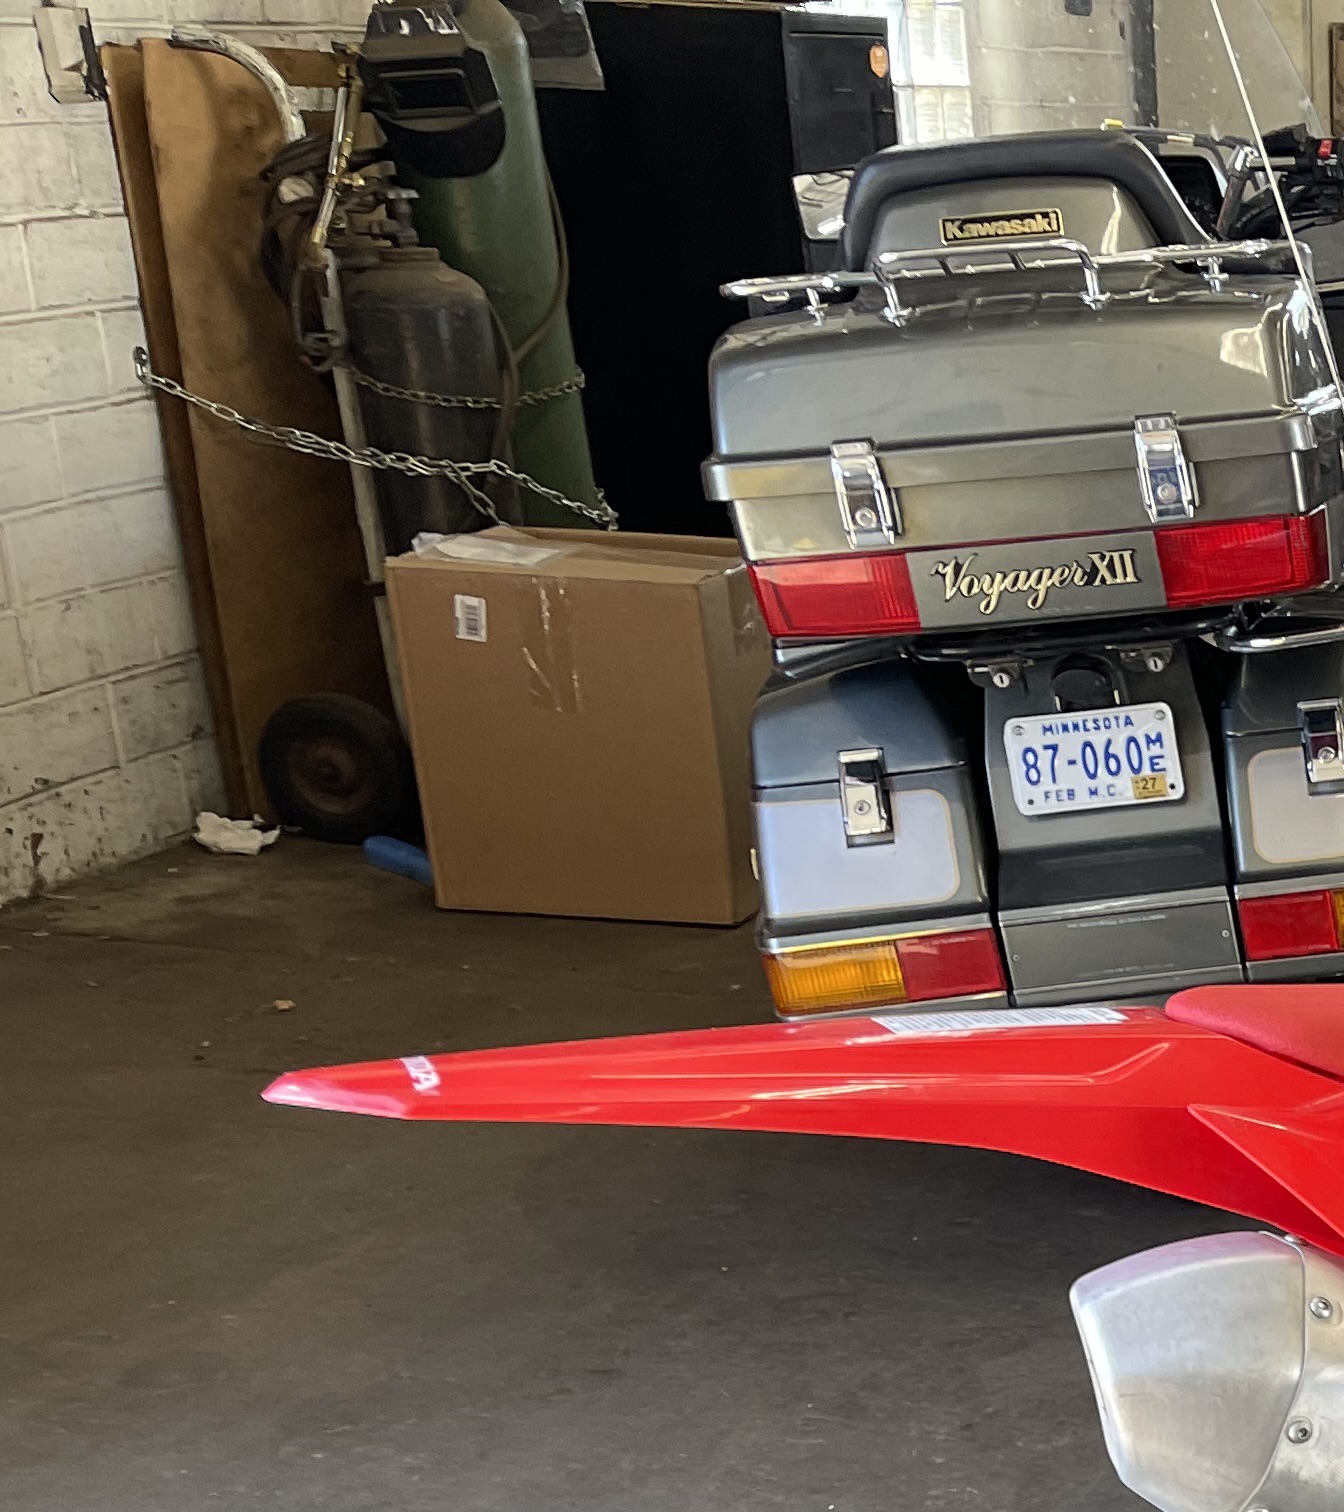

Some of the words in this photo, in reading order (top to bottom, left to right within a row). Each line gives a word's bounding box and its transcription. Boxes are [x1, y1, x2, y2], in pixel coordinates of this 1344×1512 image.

[944, 212, 1058, 239] Kawasaki
[930, 553, 1087, 614] Voyager
[1087, 549, 1140, 586] XII
[1042, 714, 1134, 736] MINNESOTA
[1022, 736, 1143, 786] 87-060
[1044, 788, 1076, 803] FEB
[1141, 777, 1157, 790] 27
